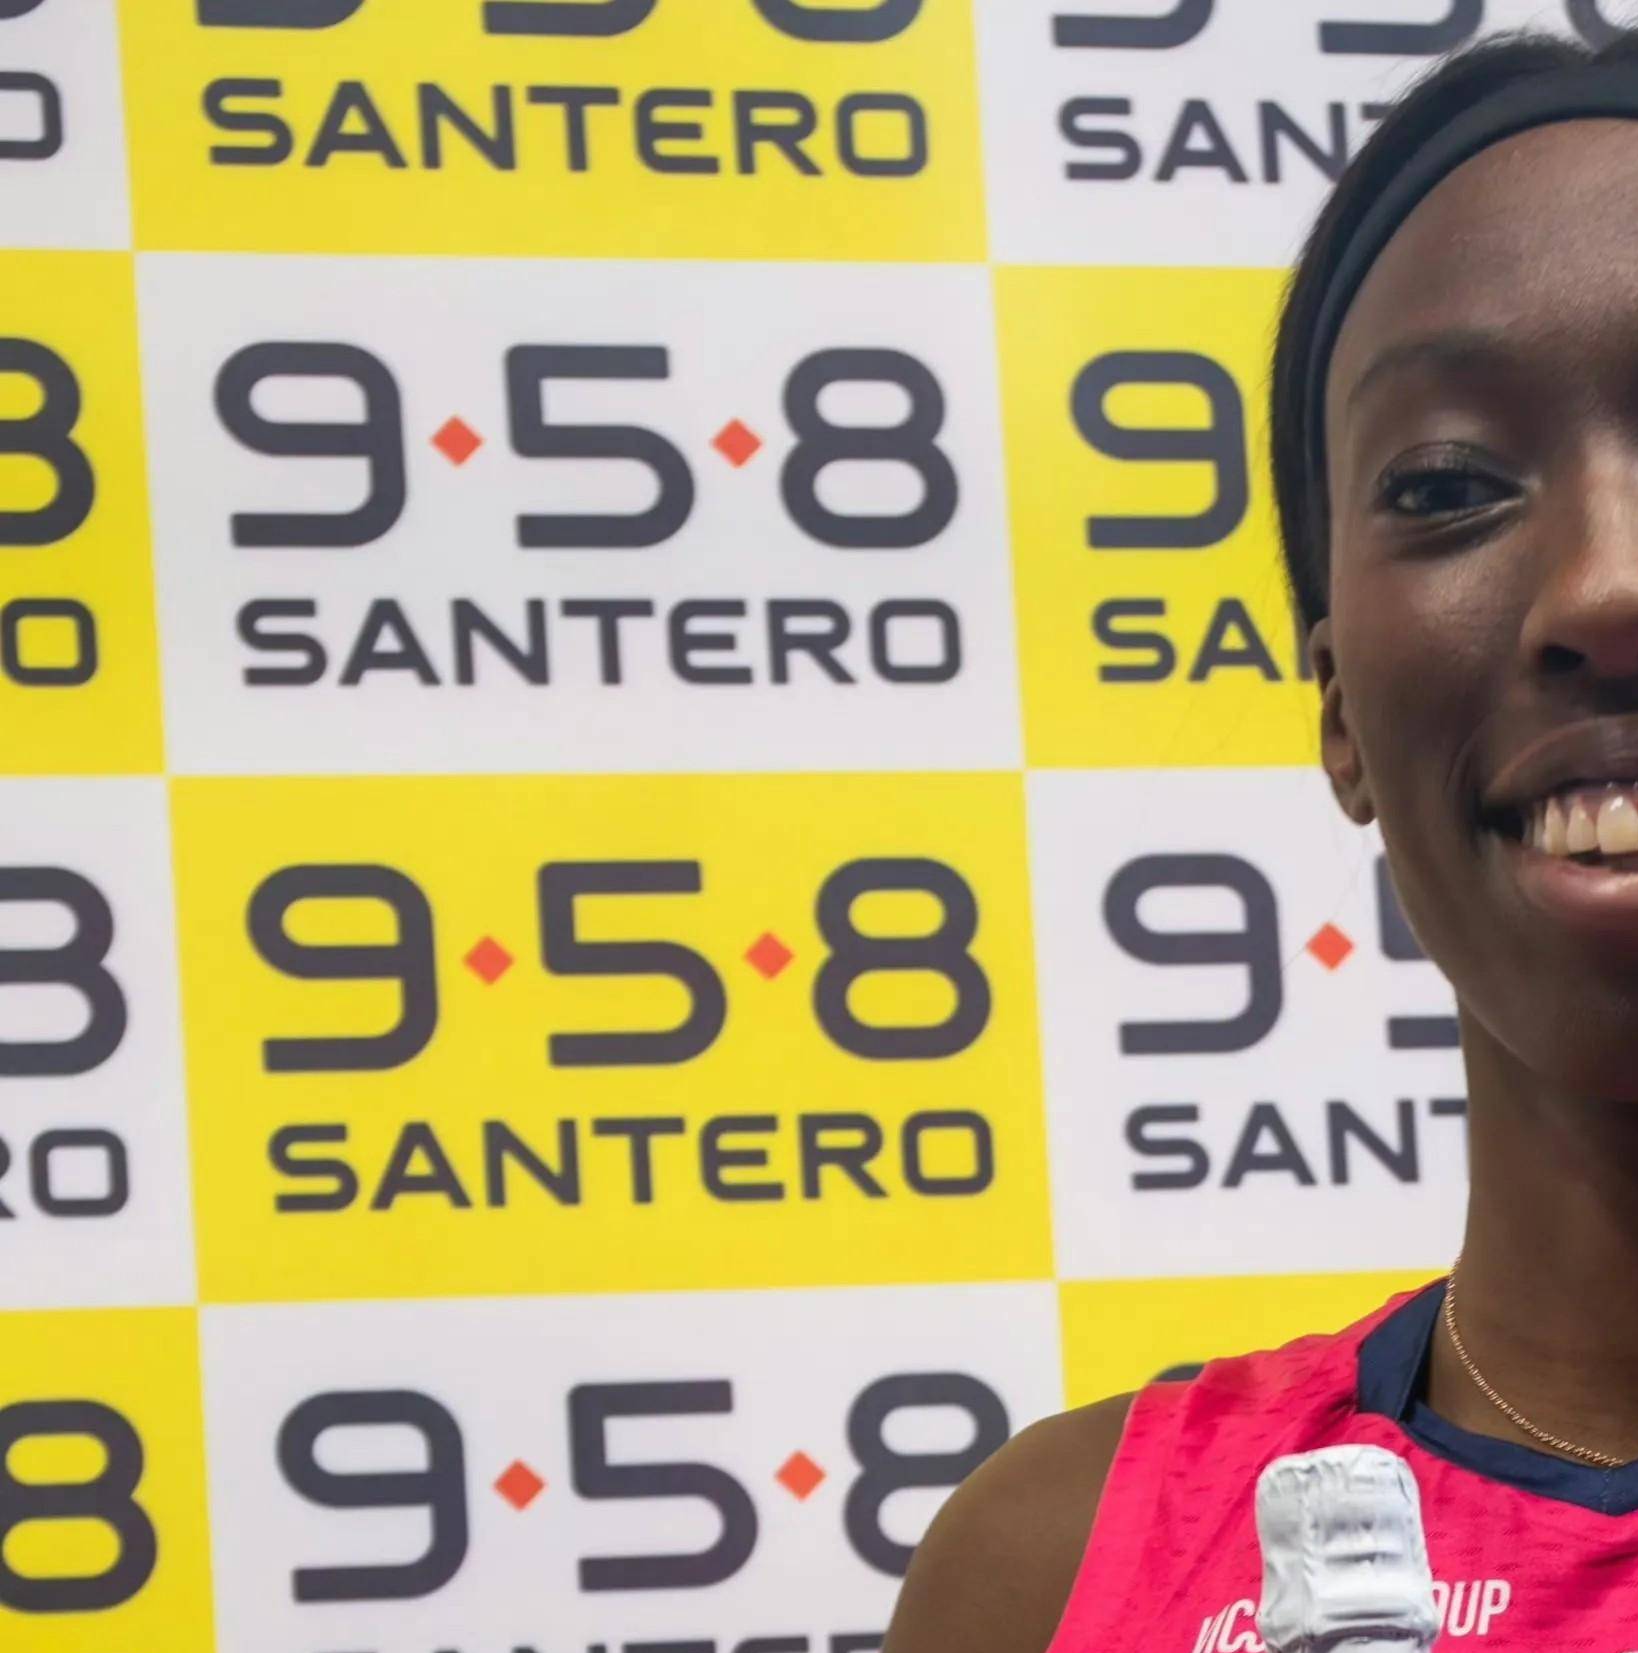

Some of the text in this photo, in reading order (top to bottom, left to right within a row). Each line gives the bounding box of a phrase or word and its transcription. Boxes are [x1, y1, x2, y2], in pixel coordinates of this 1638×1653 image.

[203, 77, 928, 177] SANTERO
[236, 598, 962, 687] SANTERO
[268, 1109, 995, 1213] SANTERO
